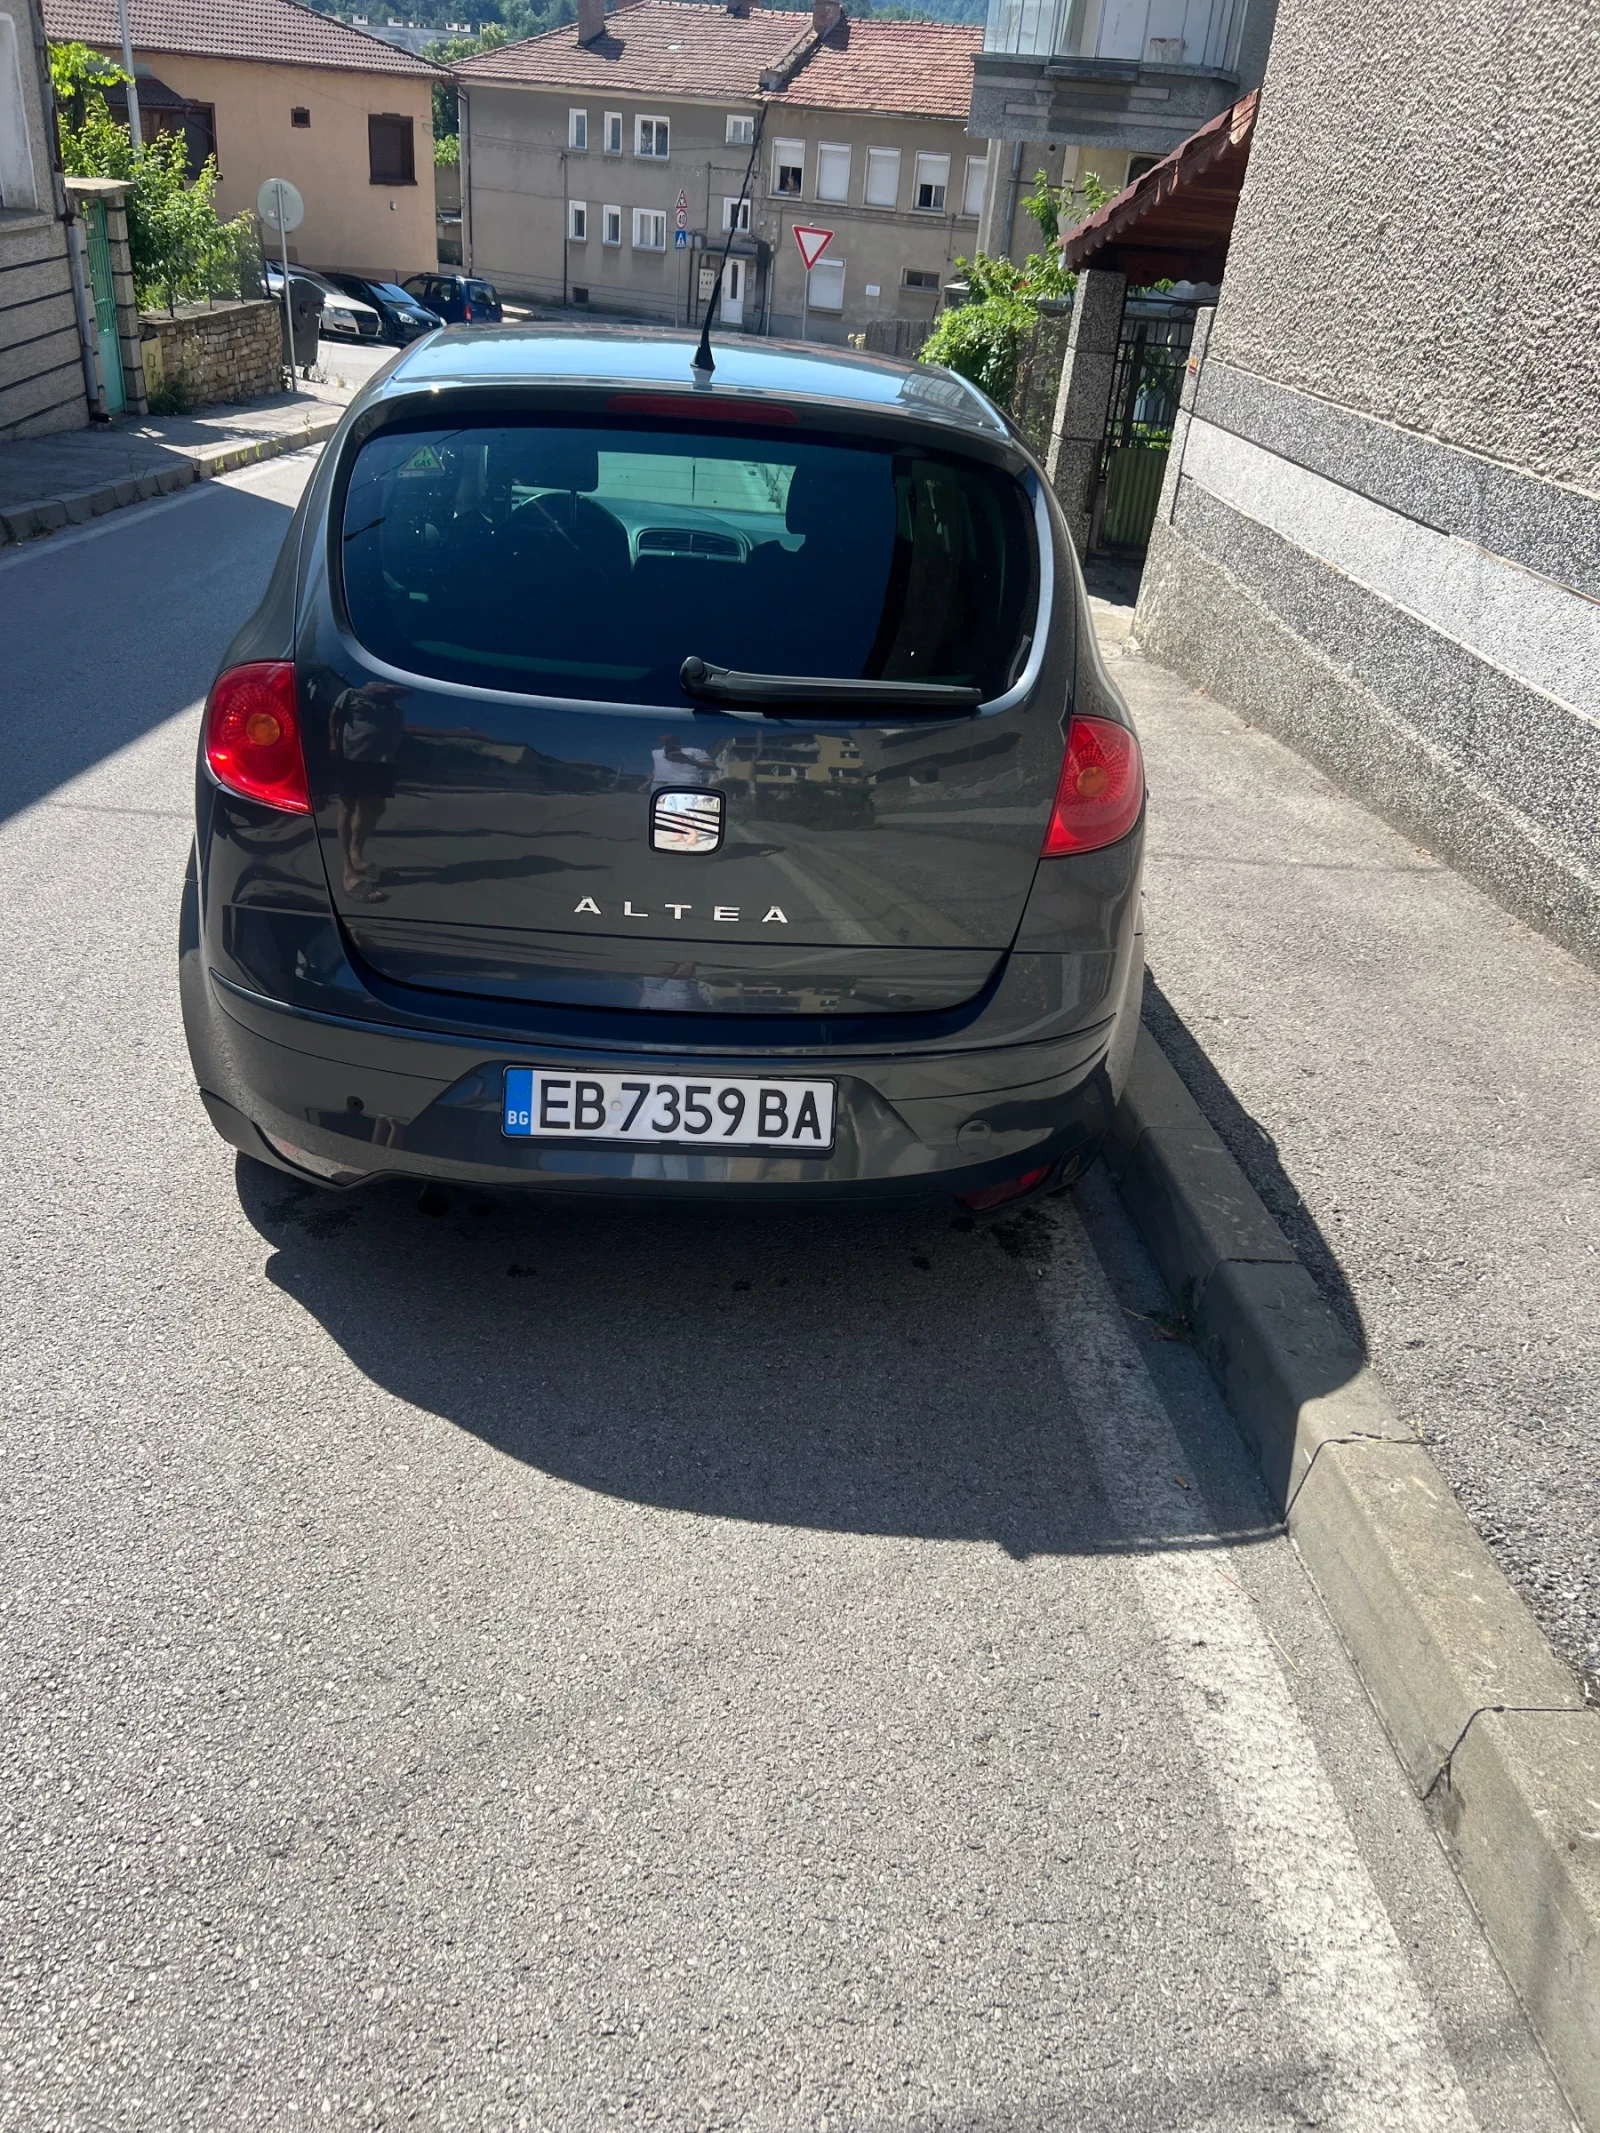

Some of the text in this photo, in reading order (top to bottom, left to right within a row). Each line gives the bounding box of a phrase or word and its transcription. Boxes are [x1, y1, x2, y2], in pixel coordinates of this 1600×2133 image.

[414, 459, 432, 468] GAS
[574, 896, 788, 923] ALTEA
[507, 1110, 529, 1126] BG
